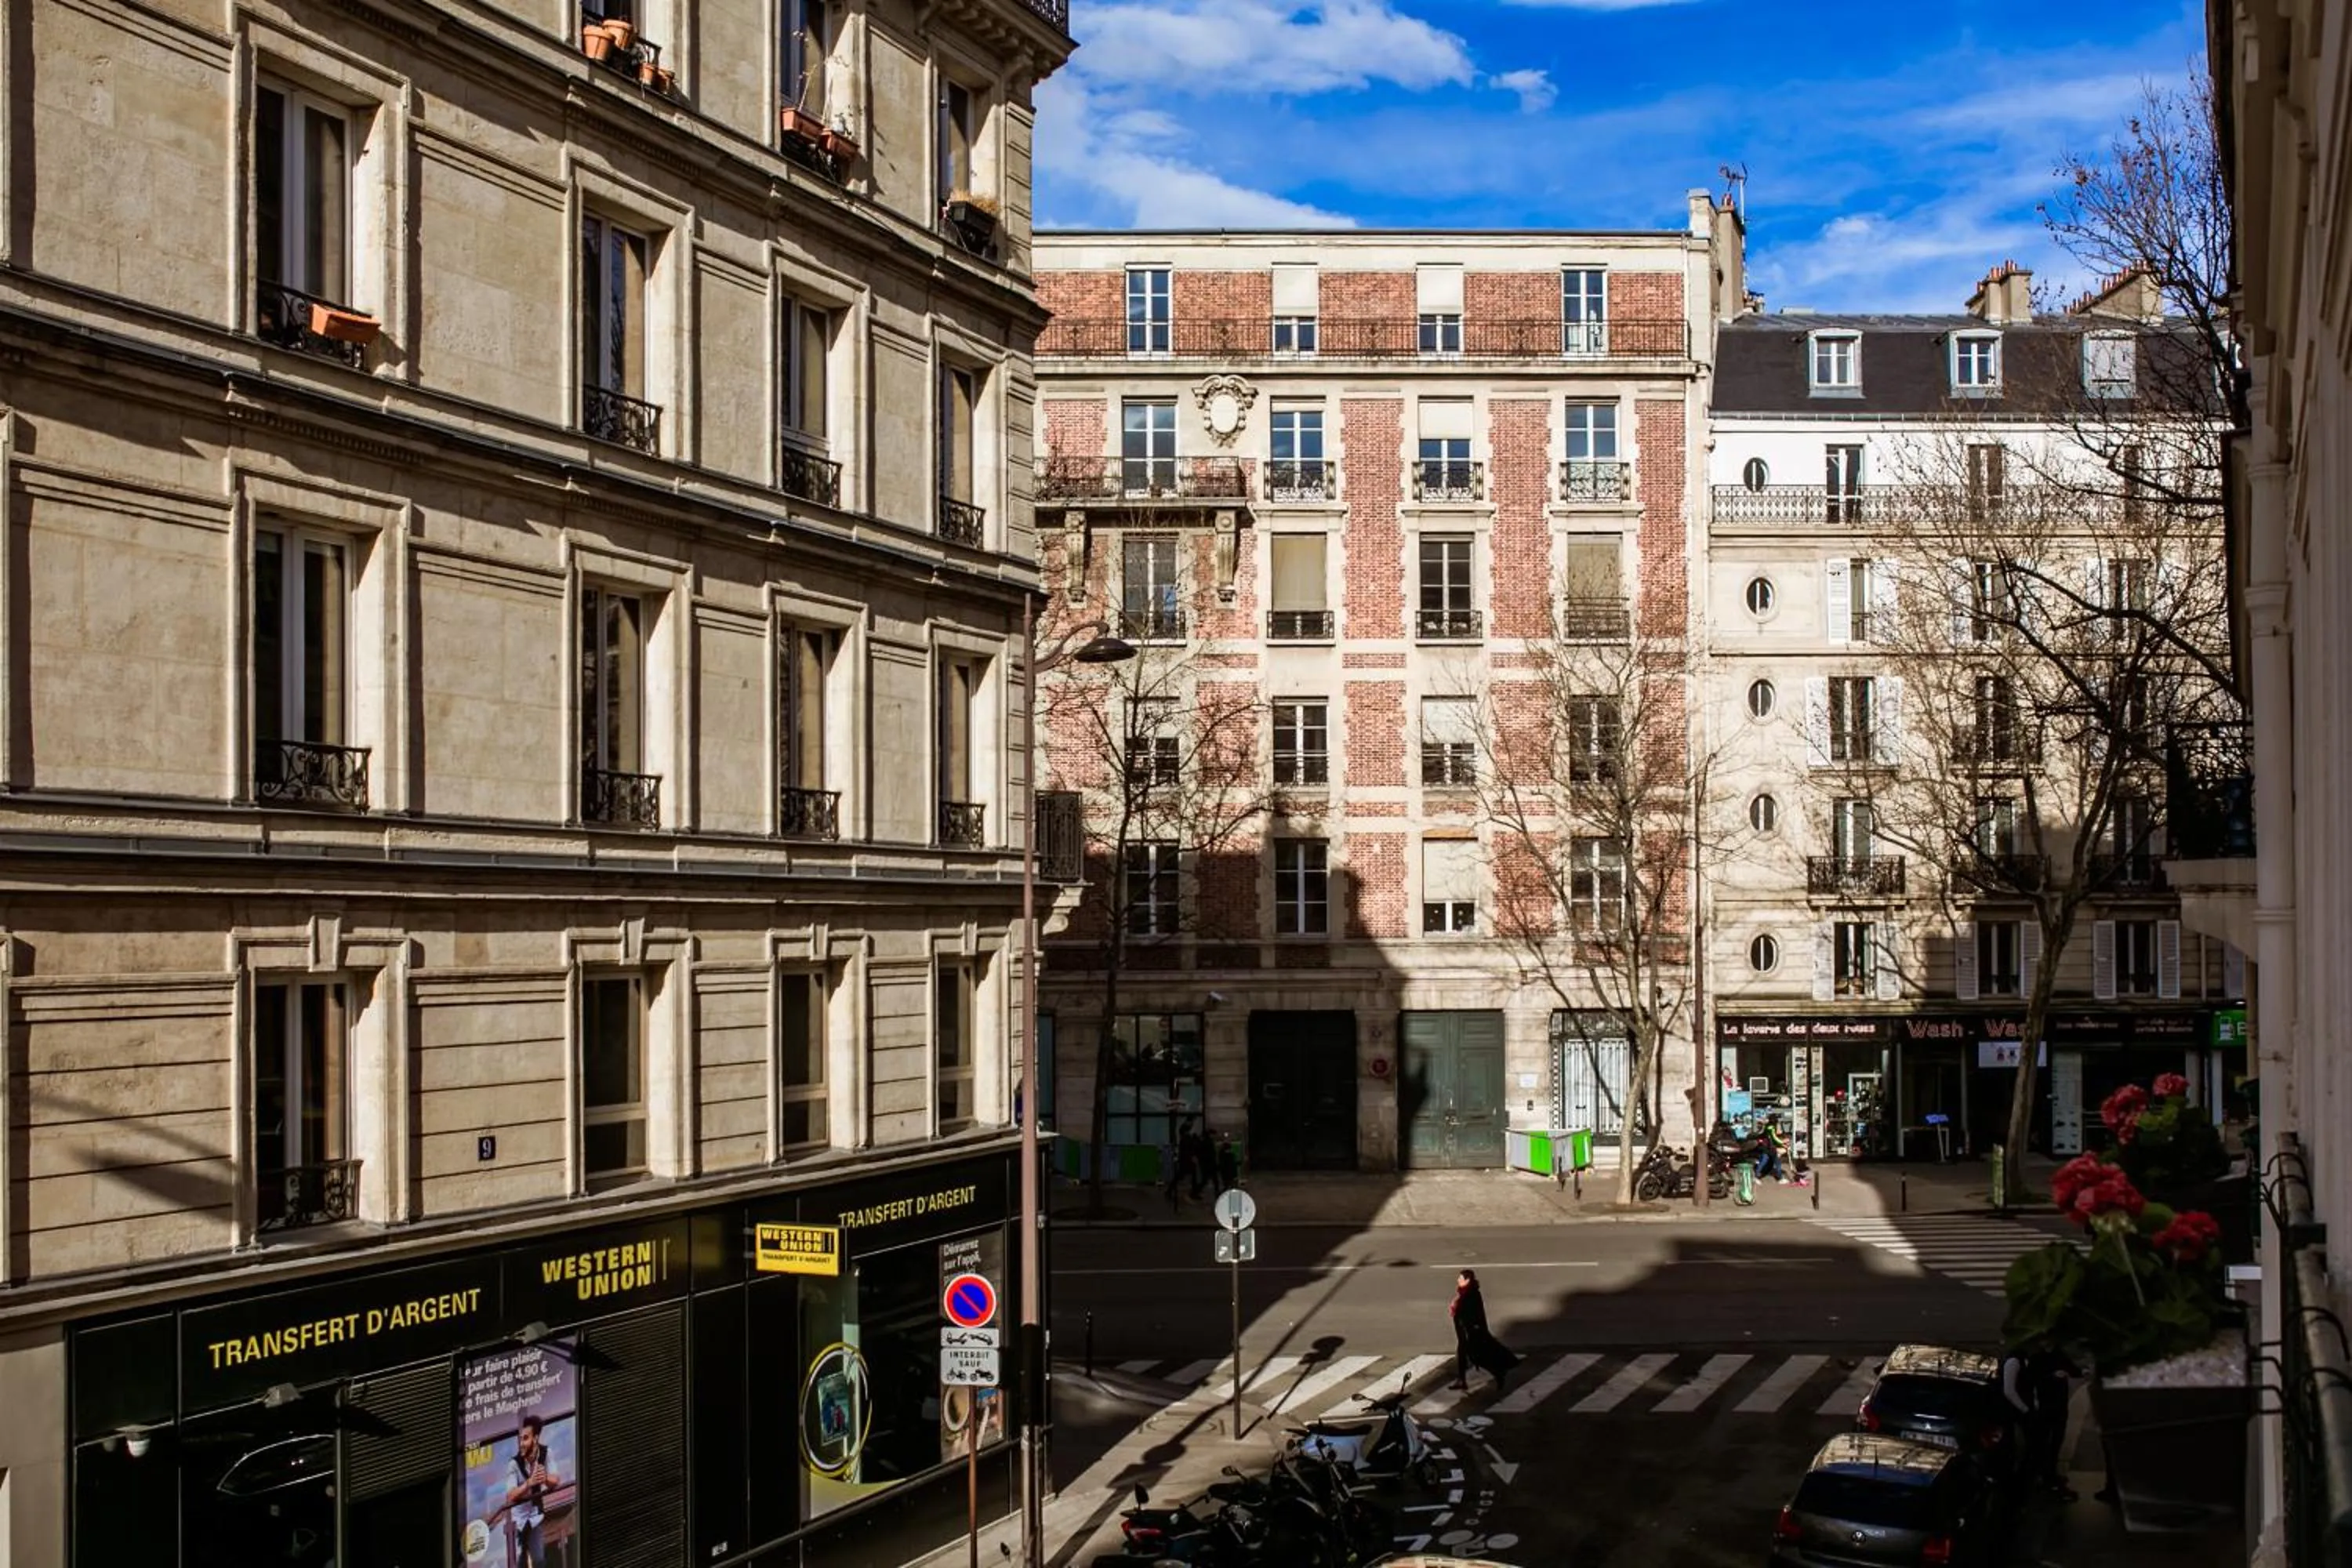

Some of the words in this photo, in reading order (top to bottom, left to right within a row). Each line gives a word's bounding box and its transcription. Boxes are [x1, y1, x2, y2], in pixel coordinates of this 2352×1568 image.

[1722, 1023, 1737, 1035] La
[1785, 1022, 1806, 1035] des
[1906, 1019, 1963, 1039] Wash
[1984, 1019, 2031, 1039] Was
[482, 1138, 492, 1158] 9
[838, 1199, 913, 1229] TRANSFERT
[916, 1185, 976, 1214] D'ARGENT
[761, 1229, 822, 1242] WESTERN
[780, 1240, 822, 1252] UNION
[542, 1240, 652, 1284] WESTERN
[577, 1263, 652, 1301] UNION
[209, 1313, 360, 1370] TRANSFERT
[366, 1288, 481, 1335] D'ARGENT
[485, 1357, 510, 1373] faire
[511, 1348, 543, 1369] plaisir
[469, 1374, 498, 1396] partir
[500, 1370, 514, 1385] de
[515, 1363, 539, 1380] 4,90
[540, 1361, 548, 1373] €
[475, 1390, 499, 1406] frais
[501, 1385, 514, 1399] de
[484, 1406, 494, 1418] le
